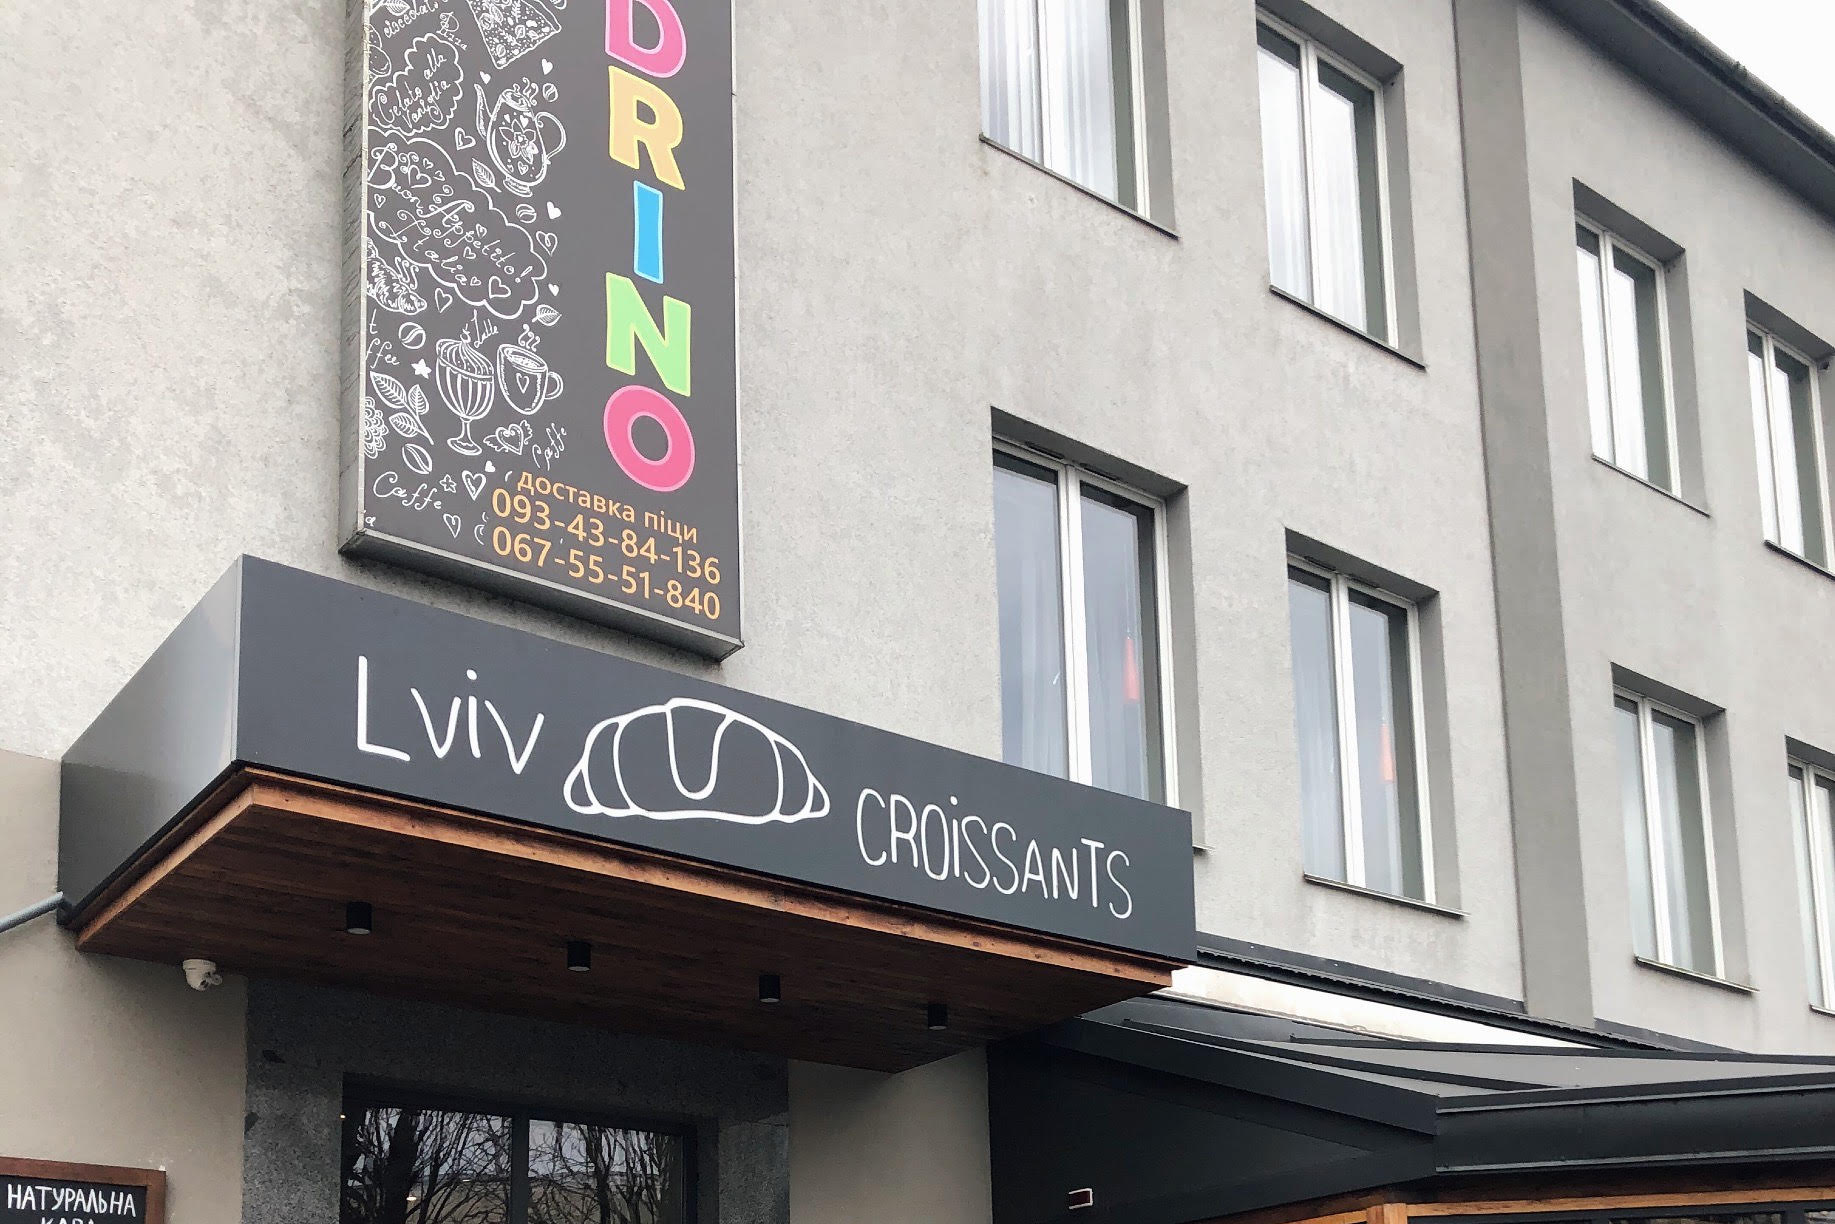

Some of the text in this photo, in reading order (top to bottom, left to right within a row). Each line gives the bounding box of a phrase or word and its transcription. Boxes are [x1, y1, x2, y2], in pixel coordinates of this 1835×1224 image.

[492, 488, 721, 585] 093-43-84-136
[517, 471, 698, 544] доставка піци
[492, 526, 721, 620] 067-55-51-840
[7, 1183, 136, 1218] НАТУРАЛЬНА
